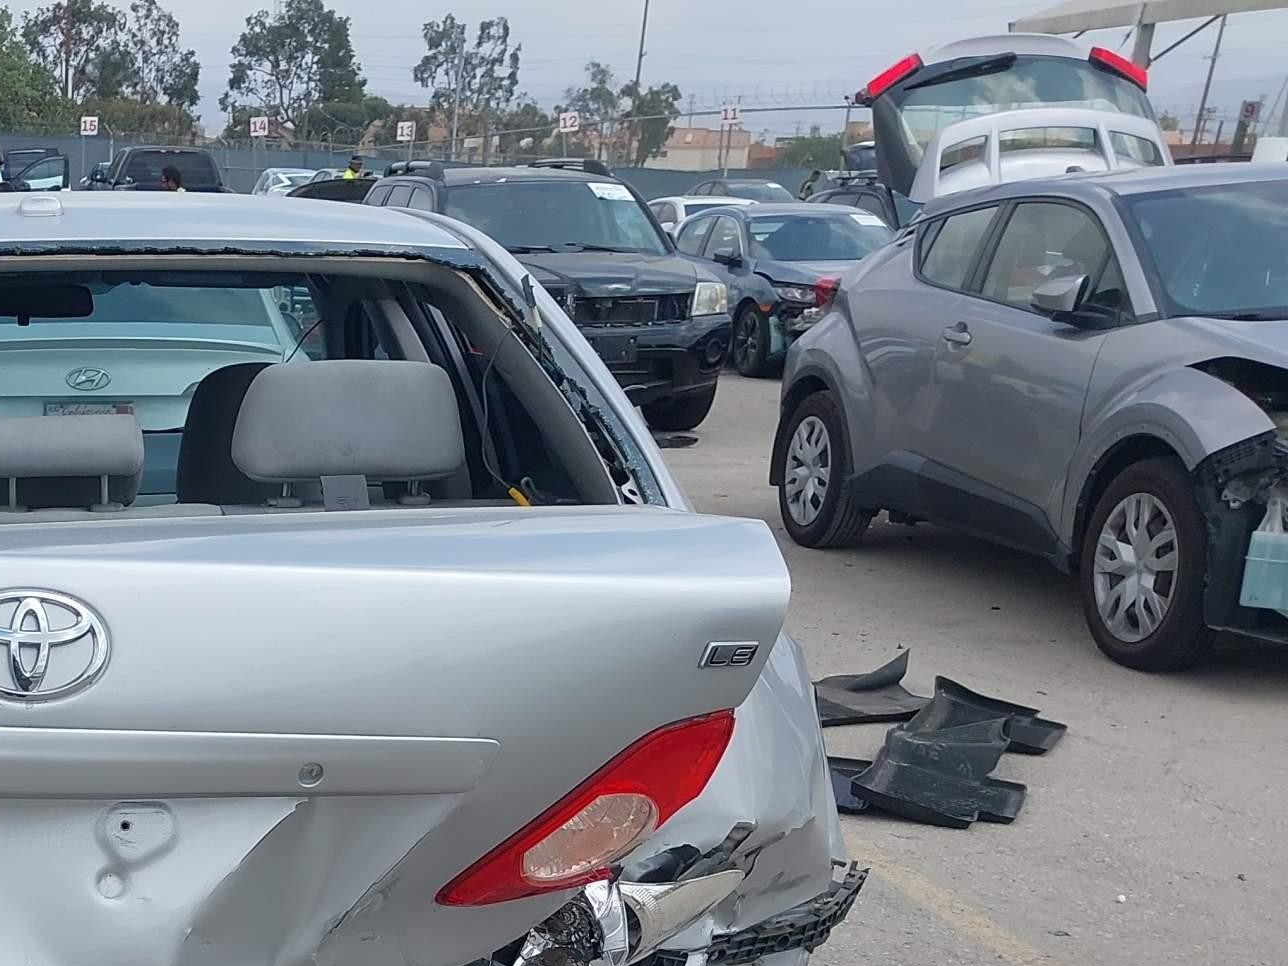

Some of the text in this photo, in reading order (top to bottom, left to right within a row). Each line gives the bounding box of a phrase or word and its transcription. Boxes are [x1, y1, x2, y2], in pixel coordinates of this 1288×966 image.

[722, 108, 738, 120] 11
[81, 119, 96, 131] 15
[252, 120, 267, 133] 14
[561, 115, 578, 128] 12
[398, 125, 412, 137] 13
[705, 643, 758, 667] LE
